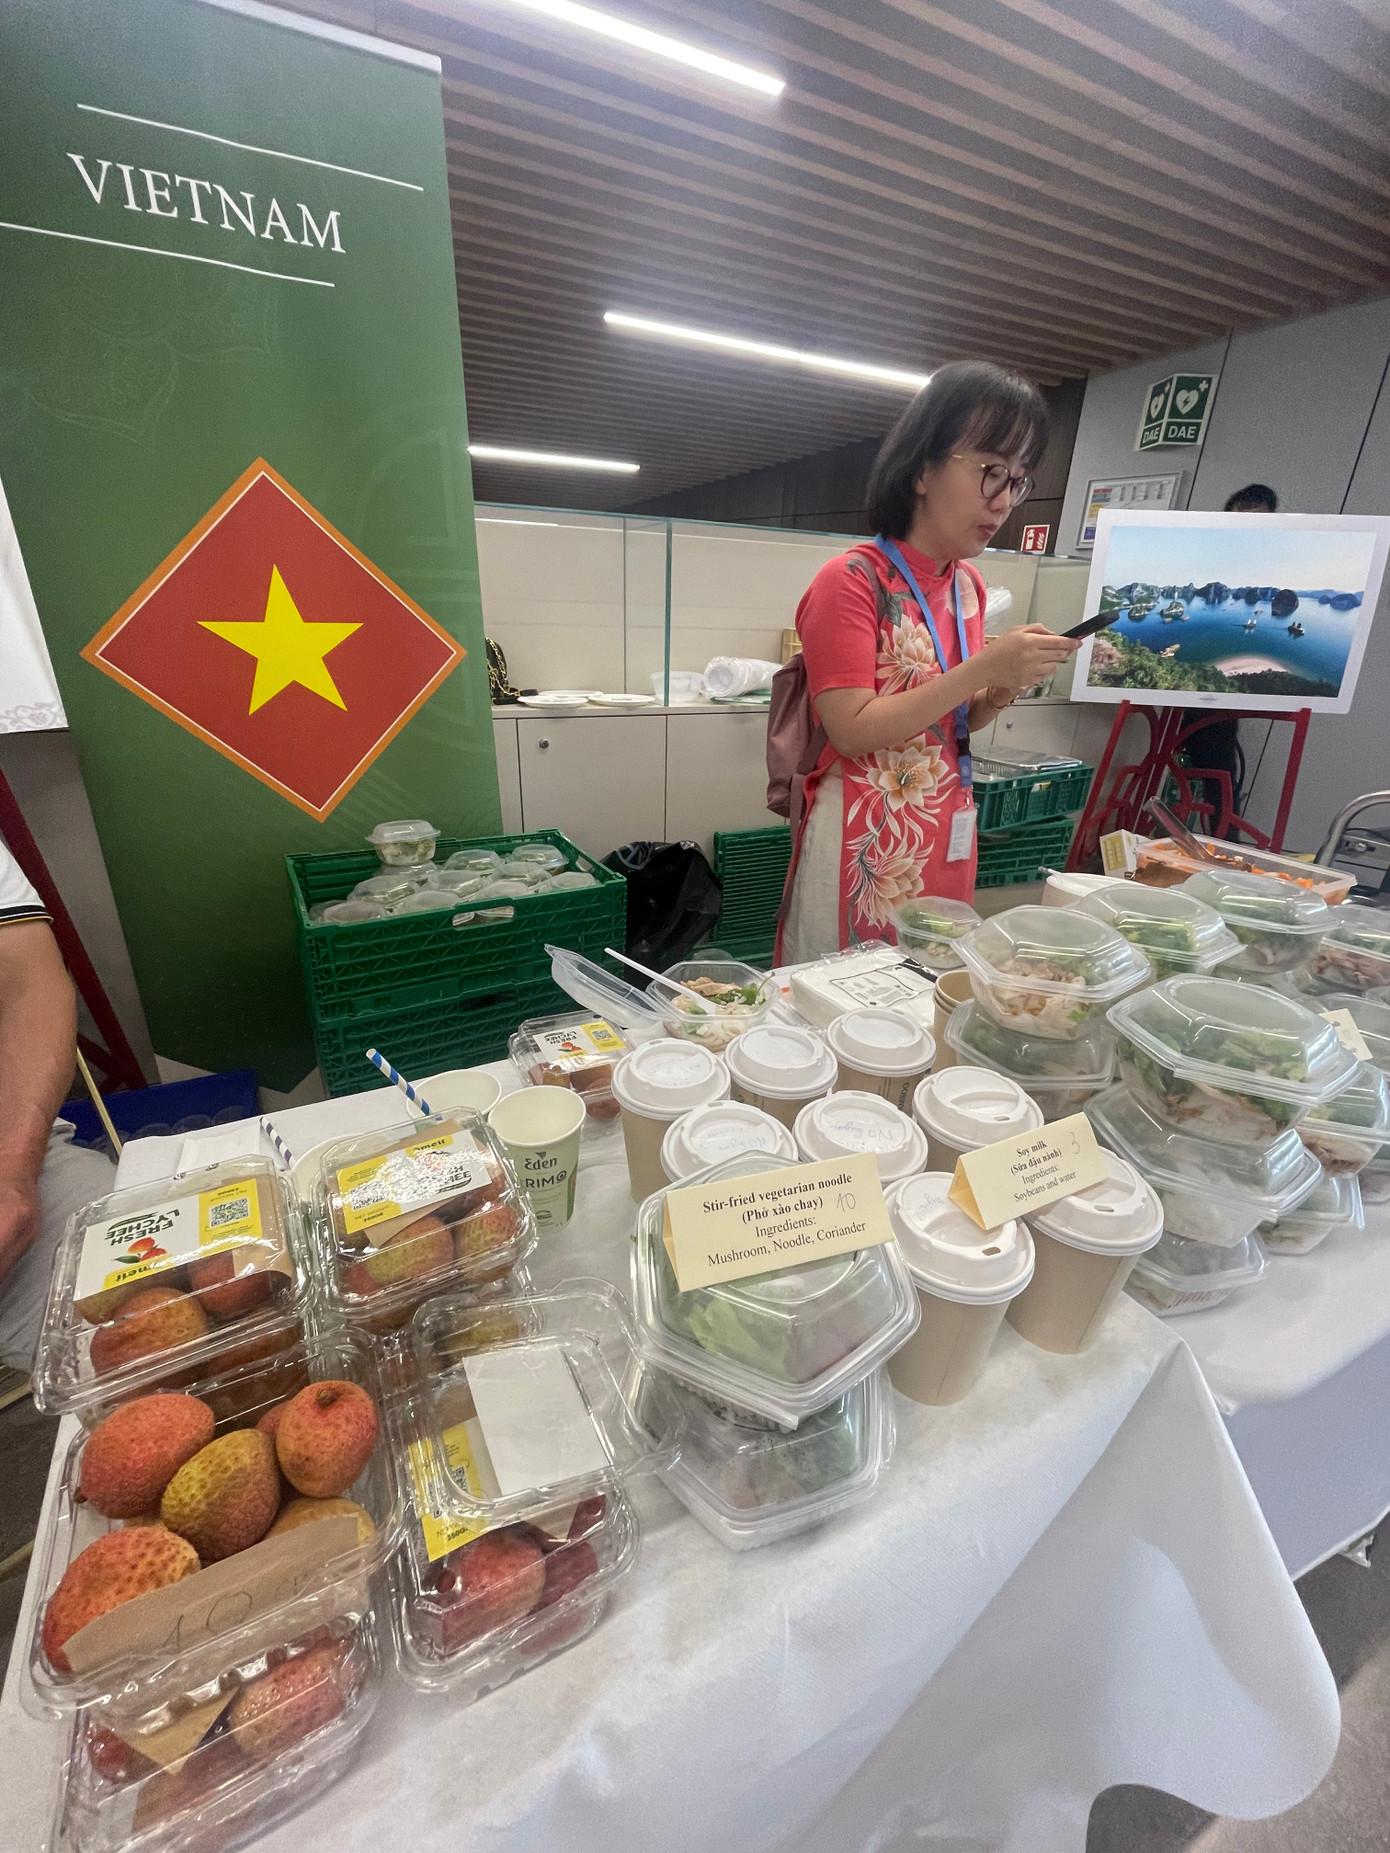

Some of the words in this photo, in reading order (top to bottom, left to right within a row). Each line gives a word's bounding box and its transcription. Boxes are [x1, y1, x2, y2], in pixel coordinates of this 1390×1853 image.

[66, 152, 346, 254] VIETNAM
[1142, 427, 1160, 444] DAE
[1168, 425, 1197, 439] DAE
[545, 1030, 577, 1042] LYCHEE
[550, 1035, 577, 1045] FRESH
[1016, 1147, 1030, 1158] Soy
[1031, 1140, 1047, 1152] milk
[1069, 1131, 1081, 1155] 3
[524, 1157, 557, 1171] Eden
[1029, 1156, 1042, 1168] đậu
[1022, 1164, 1060, 1185] Ingredients:
[703, 1192, 756, 1213] Stir-fried
[759, 1182, 815, 1203] vegetarian
[818, 1173, 852, 1190] noodle
[1013, 1184, 1046, 1202] Soybeans
[1046, 1177, 1058, 1189] and
[1059, 1171, 1076, 1183] water
[742, 1207, 769, 1225] (Phở
[772, 1203, 791, 1217] xào
[794, 1196, 823, 1212] chay)
[836, 1192, 856, 1213] 10
[104, 1208, 180, 1241] LYCHEE
[110, 1219, 174, 1247] FRESH
[755, 1216, 817, 1238] Ingredients:
[707, 1243, 771, 1267] Mushroom,
[773, 1233, 815, 1252] Noodle,
[816, 1221, 867, 1242] Coriander
[162, 1590, 252, 1654] 10
